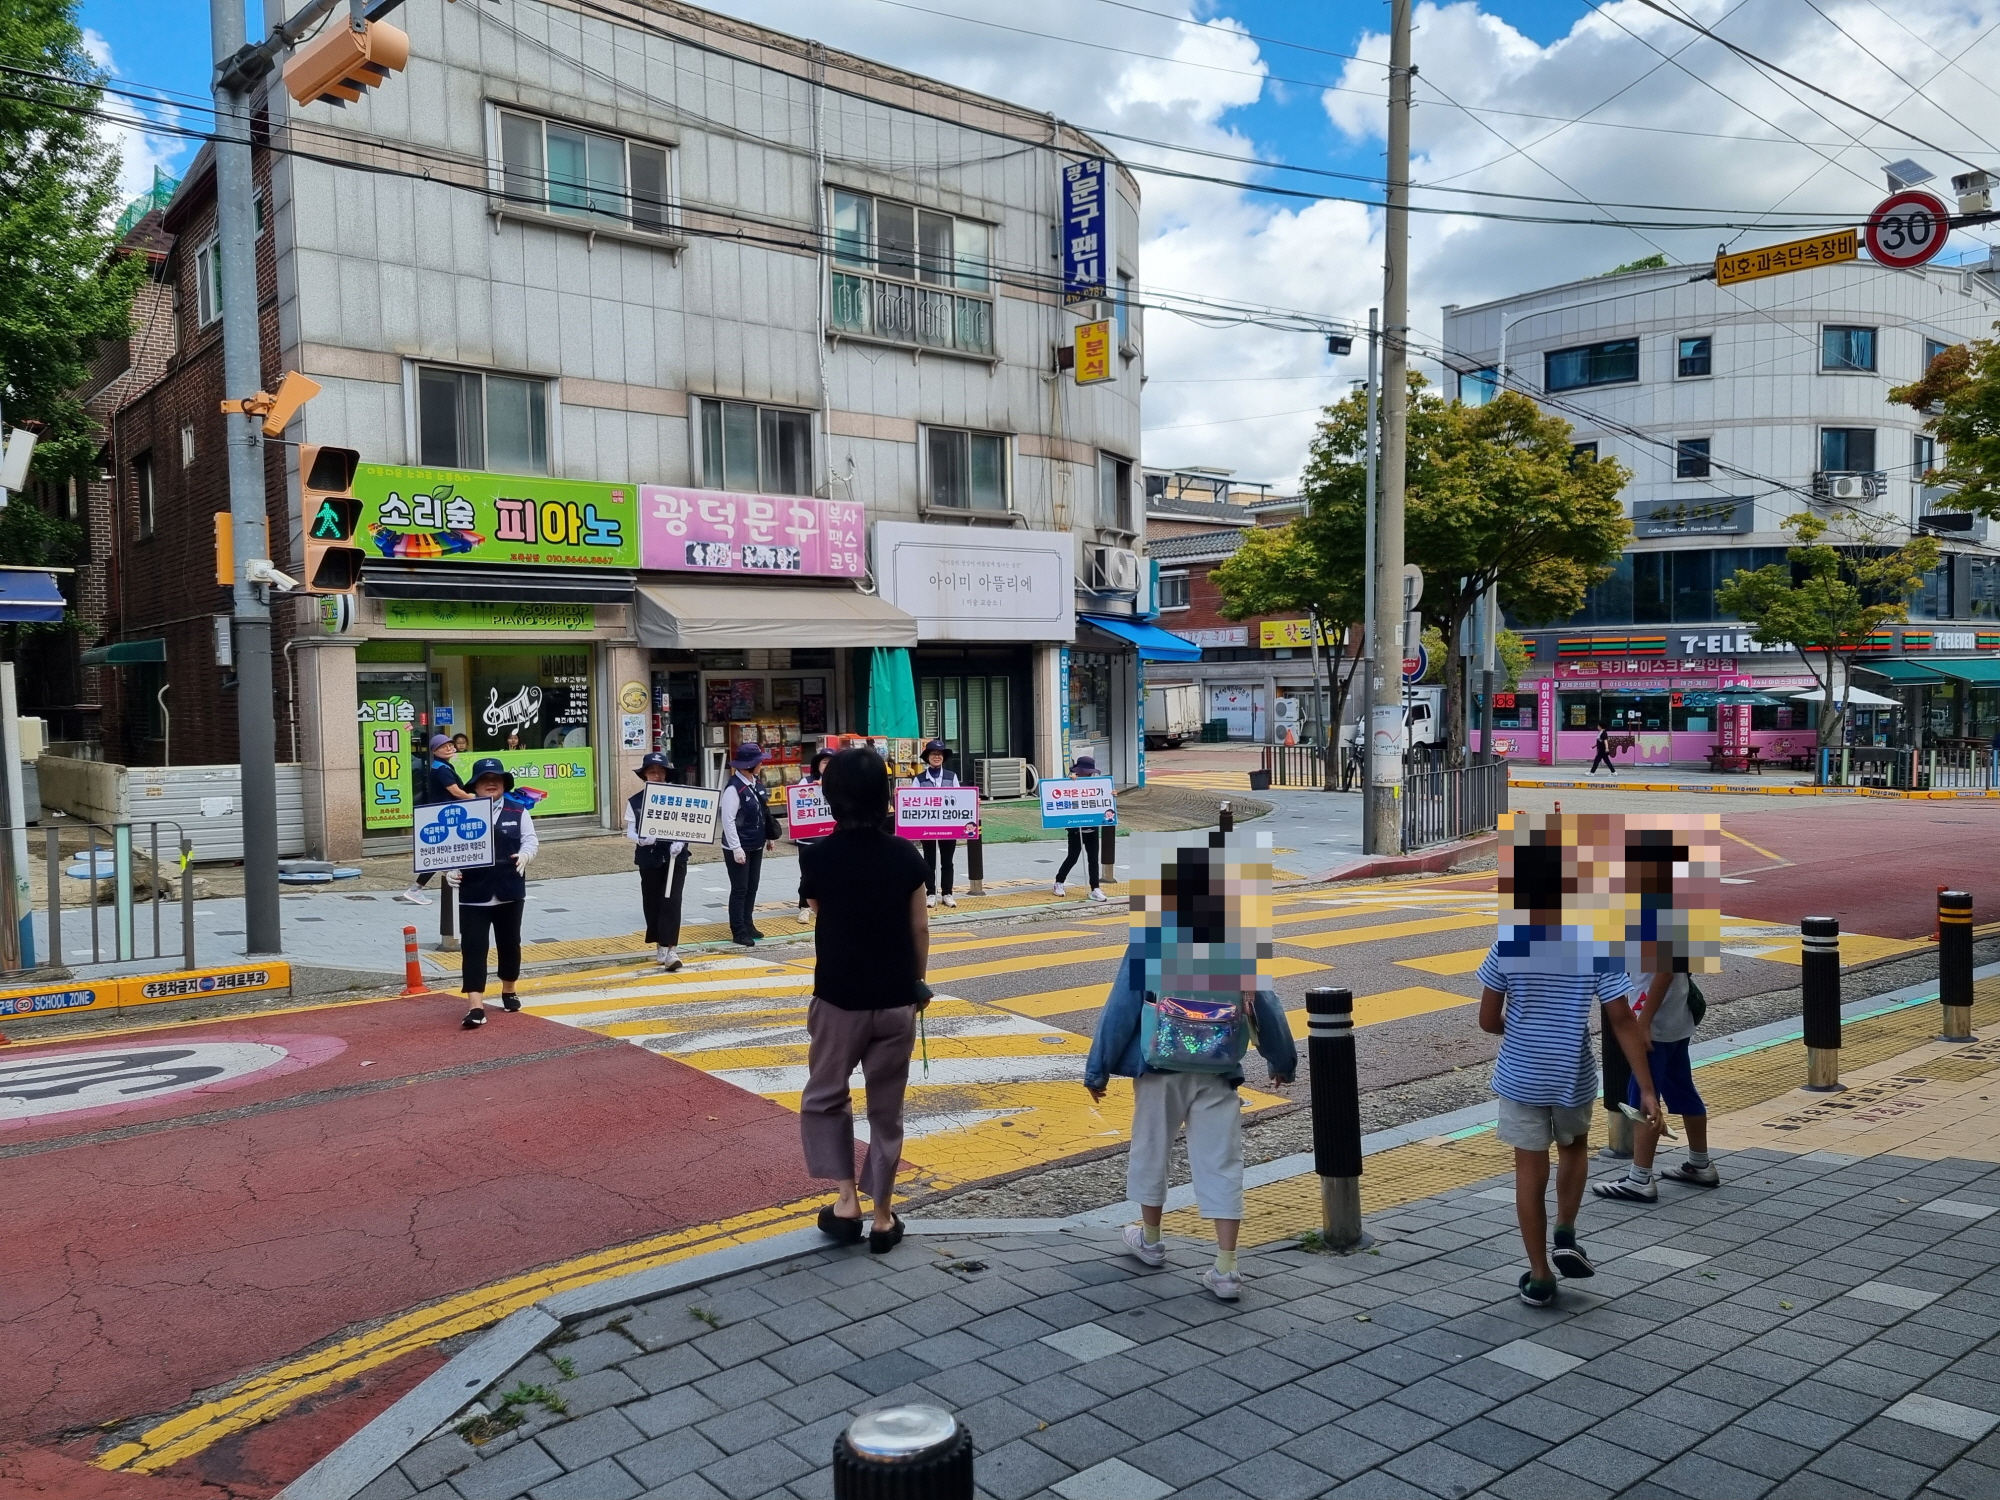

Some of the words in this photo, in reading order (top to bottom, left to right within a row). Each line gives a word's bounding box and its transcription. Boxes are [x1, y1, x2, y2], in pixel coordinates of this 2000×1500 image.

[1881, 210, 1931, 250] 30
[1721, 235, 1853, 279] 신호·과속단속장비
[1080, 323, 1107, 339] 광덕
[1084, 339, 1103, 377] 분식
[379, 490, 476, 530] 소리숲
[493, 498, 624, 547] 피아노
[653, 494, 820, 543] 광덕문구
[828, 502, 858, 526] 복사
[828, 529, 858, 549] 팩스
[830, 552, 858, 573] 코팅
[929, 572, 971, 592] 아이미
[978, 574, 1032, 593] 아뜰리에
[491, 615, 536, 626] PIANO
[1934, 632, 1976, 649] 7-ELEVEN
[357, 700, 415, 722] 소리숲
[1541, 682, 1550, 753] 아이스크림할인점
[373, 729, 401, 805] 피아노
[509, 766, 540, 778] 소리숲
[543, 763, 587, 779] 피아노
[651, 794, 682, 807] 아동범죄
[796, 796, 824, 809] 친구와
[902, 796, 921, 808] 낯선
[923, 796, 942, 807] 사람
[1063, 788, 1079, 798] 작은
[1081, 787, 1104, 798] 신고가
[796, 807, 816, 819] 혼자
[902, 808, 939, 820] 따라가지
[942, 808, 973, 820] 않아요!
[1046, 801, 1054, 810] 큰
[647, 809, 678, 821] 로보캅이
[681, 812, 711, 824] 책임진다
[147, 978, 198, 998] 주정차금지
[216, 971, 266, 989] 과태료부과
[18, 1001, 30, 1010] 30
[34, 994, 68, 1011] SCHOOL
[69, 991, 91, 1006] ZONE
